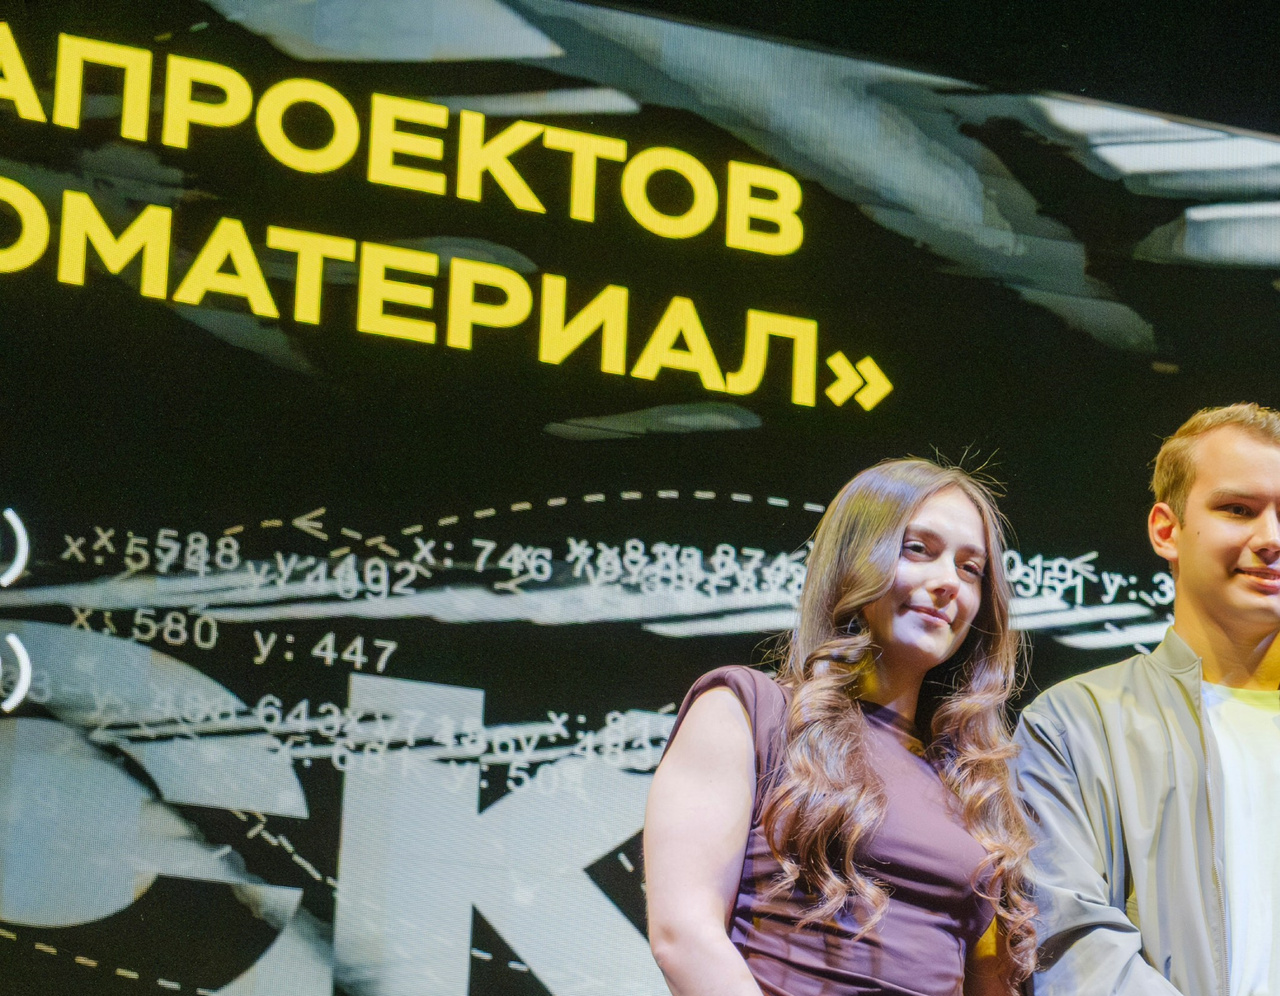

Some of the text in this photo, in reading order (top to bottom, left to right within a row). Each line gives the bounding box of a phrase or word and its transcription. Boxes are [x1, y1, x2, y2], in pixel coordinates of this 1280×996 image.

[132, 607, 218, 650] 580
[253, 629, 294, 664] y:
[311, 631, 398, 673] 447
